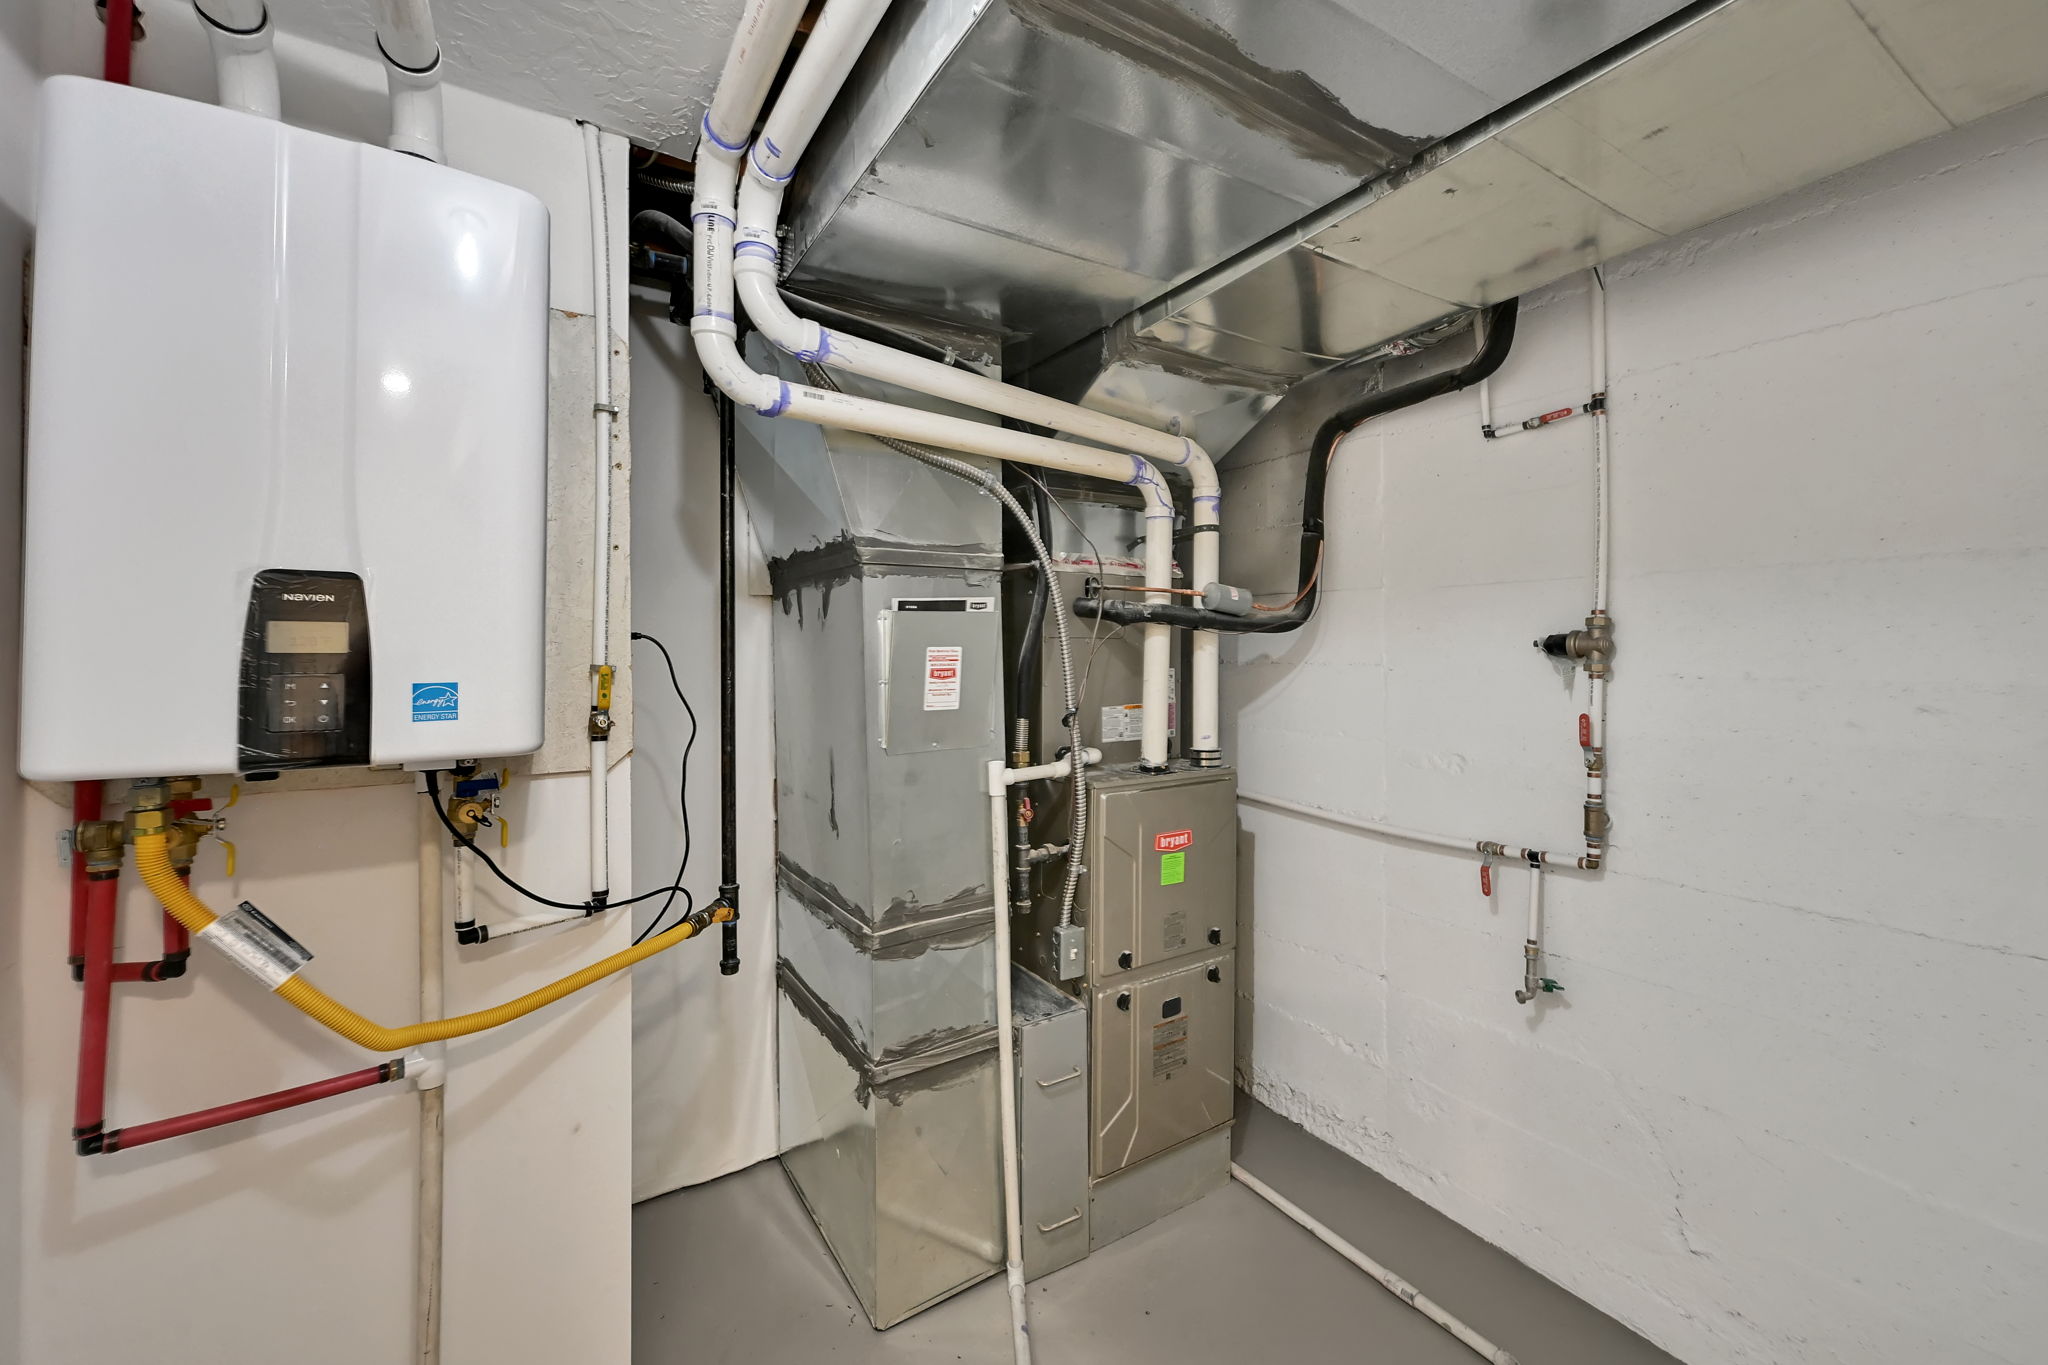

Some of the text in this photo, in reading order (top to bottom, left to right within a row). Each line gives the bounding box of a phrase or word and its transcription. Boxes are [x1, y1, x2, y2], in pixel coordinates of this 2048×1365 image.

[414, 712, 457, 721] ENERGY STAR
[1160, 833, 1188, 847] bryant
